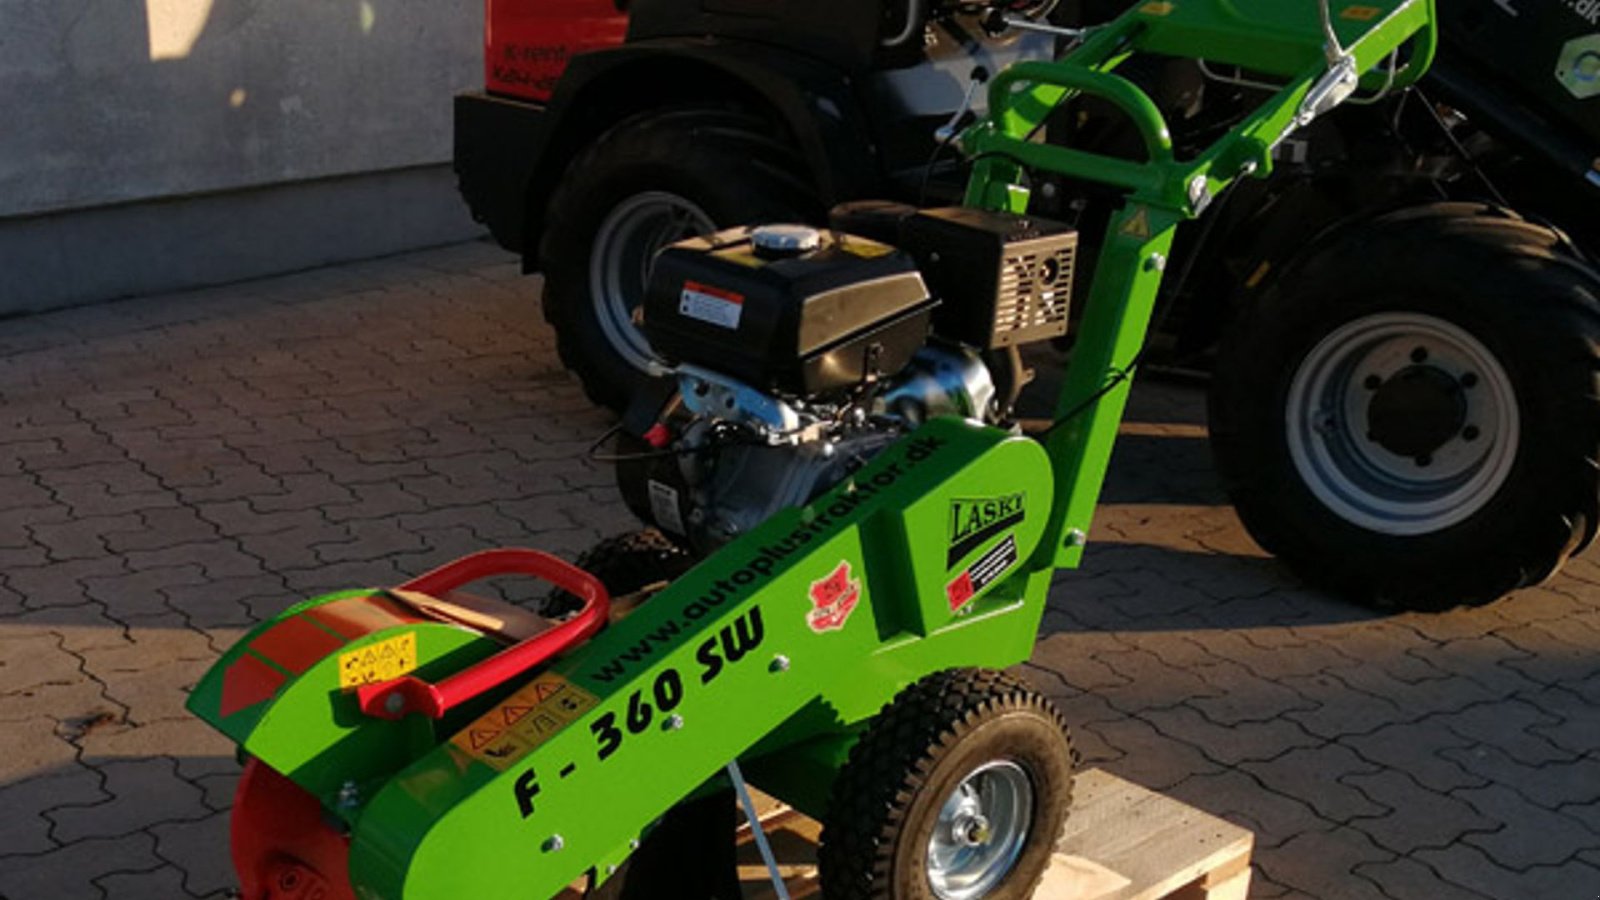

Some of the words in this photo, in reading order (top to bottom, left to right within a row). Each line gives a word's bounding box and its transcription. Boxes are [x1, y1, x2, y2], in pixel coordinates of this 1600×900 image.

[594, 436, 943, 683] www.autoplustraktor.dk
[513, 767, 541, 819] F
[589, 668, 683, 761] 360
[695, 604, 764, 684] SW
